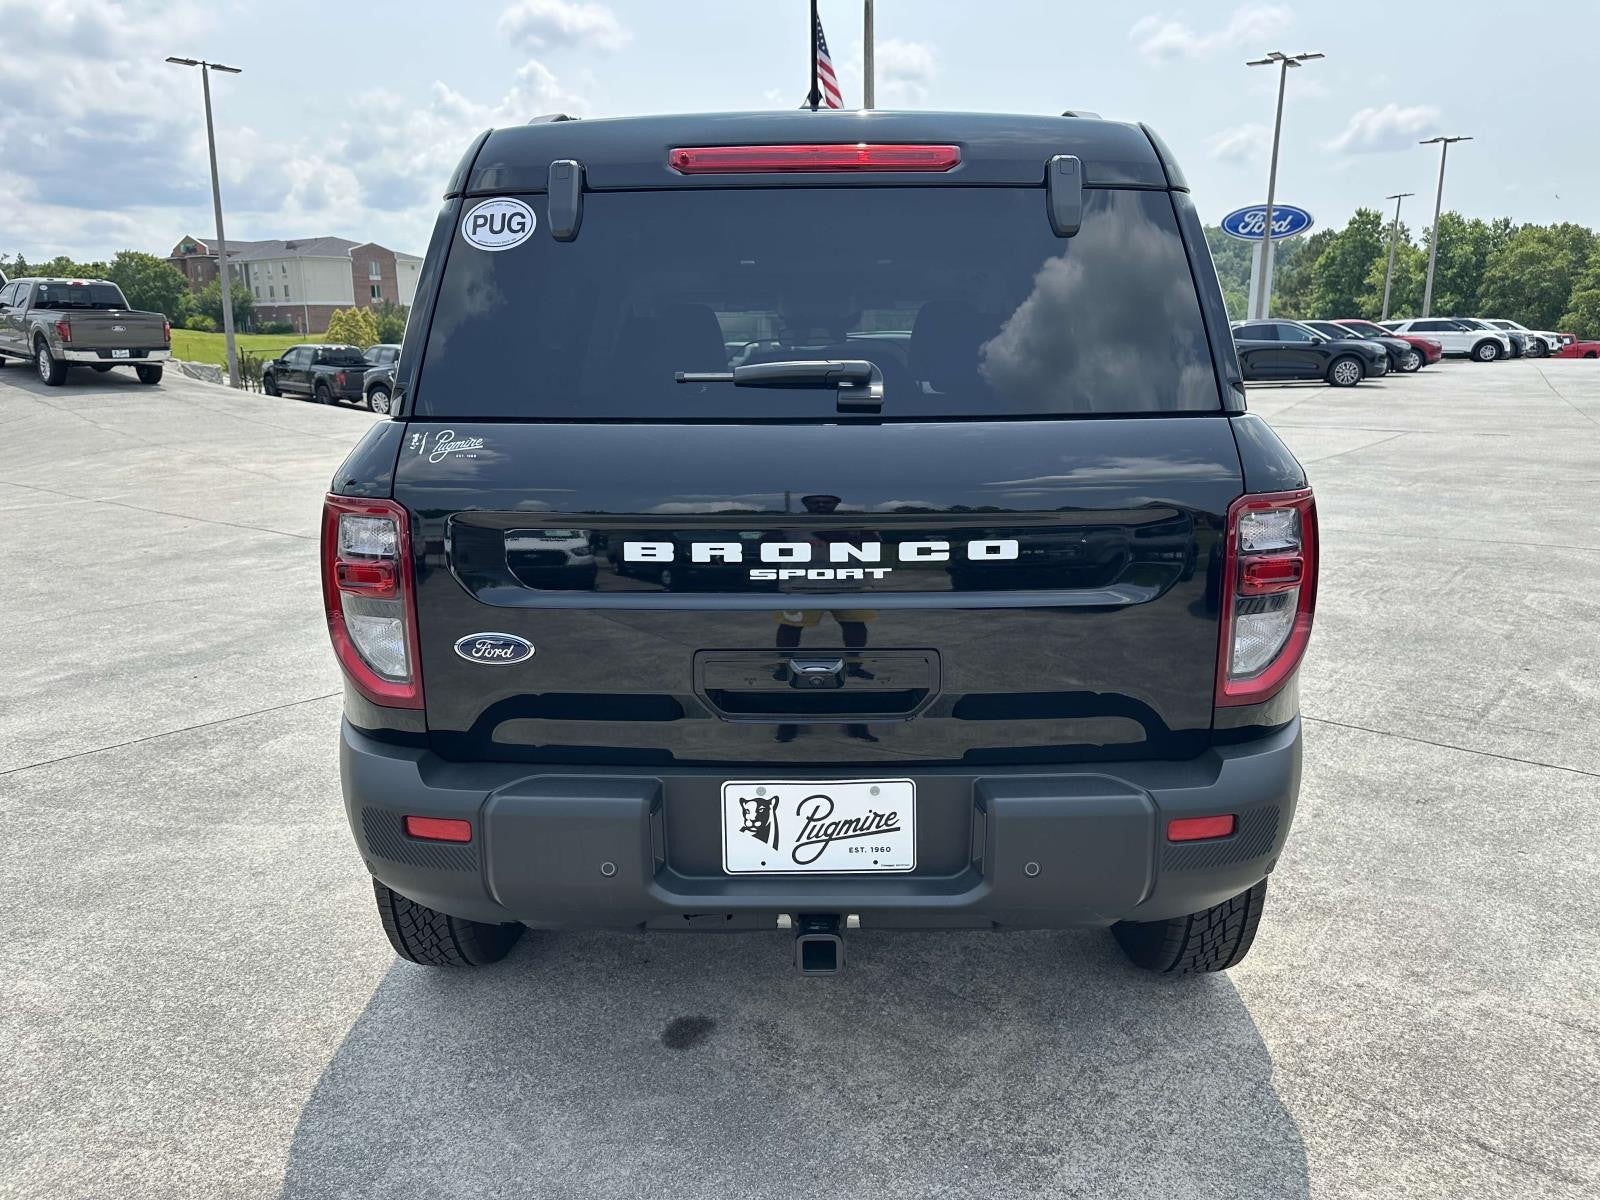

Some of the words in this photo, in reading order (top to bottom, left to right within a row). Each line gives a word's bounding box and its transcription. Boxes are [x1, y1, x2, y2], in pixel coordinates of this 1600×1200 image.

[471, 212, 526, 236] PUG
[1238, 210, 1292, 234] Fod
[428, 429, 484, 464] Pugmire
[623, 540, 1019, 563] BRONCO
[749, 568, 893, 580] SPORT
[472, 640, 515, 658] Ford
[791, 794, 901, 865] Pugmire
[848, 846, 867, 854] EST.
